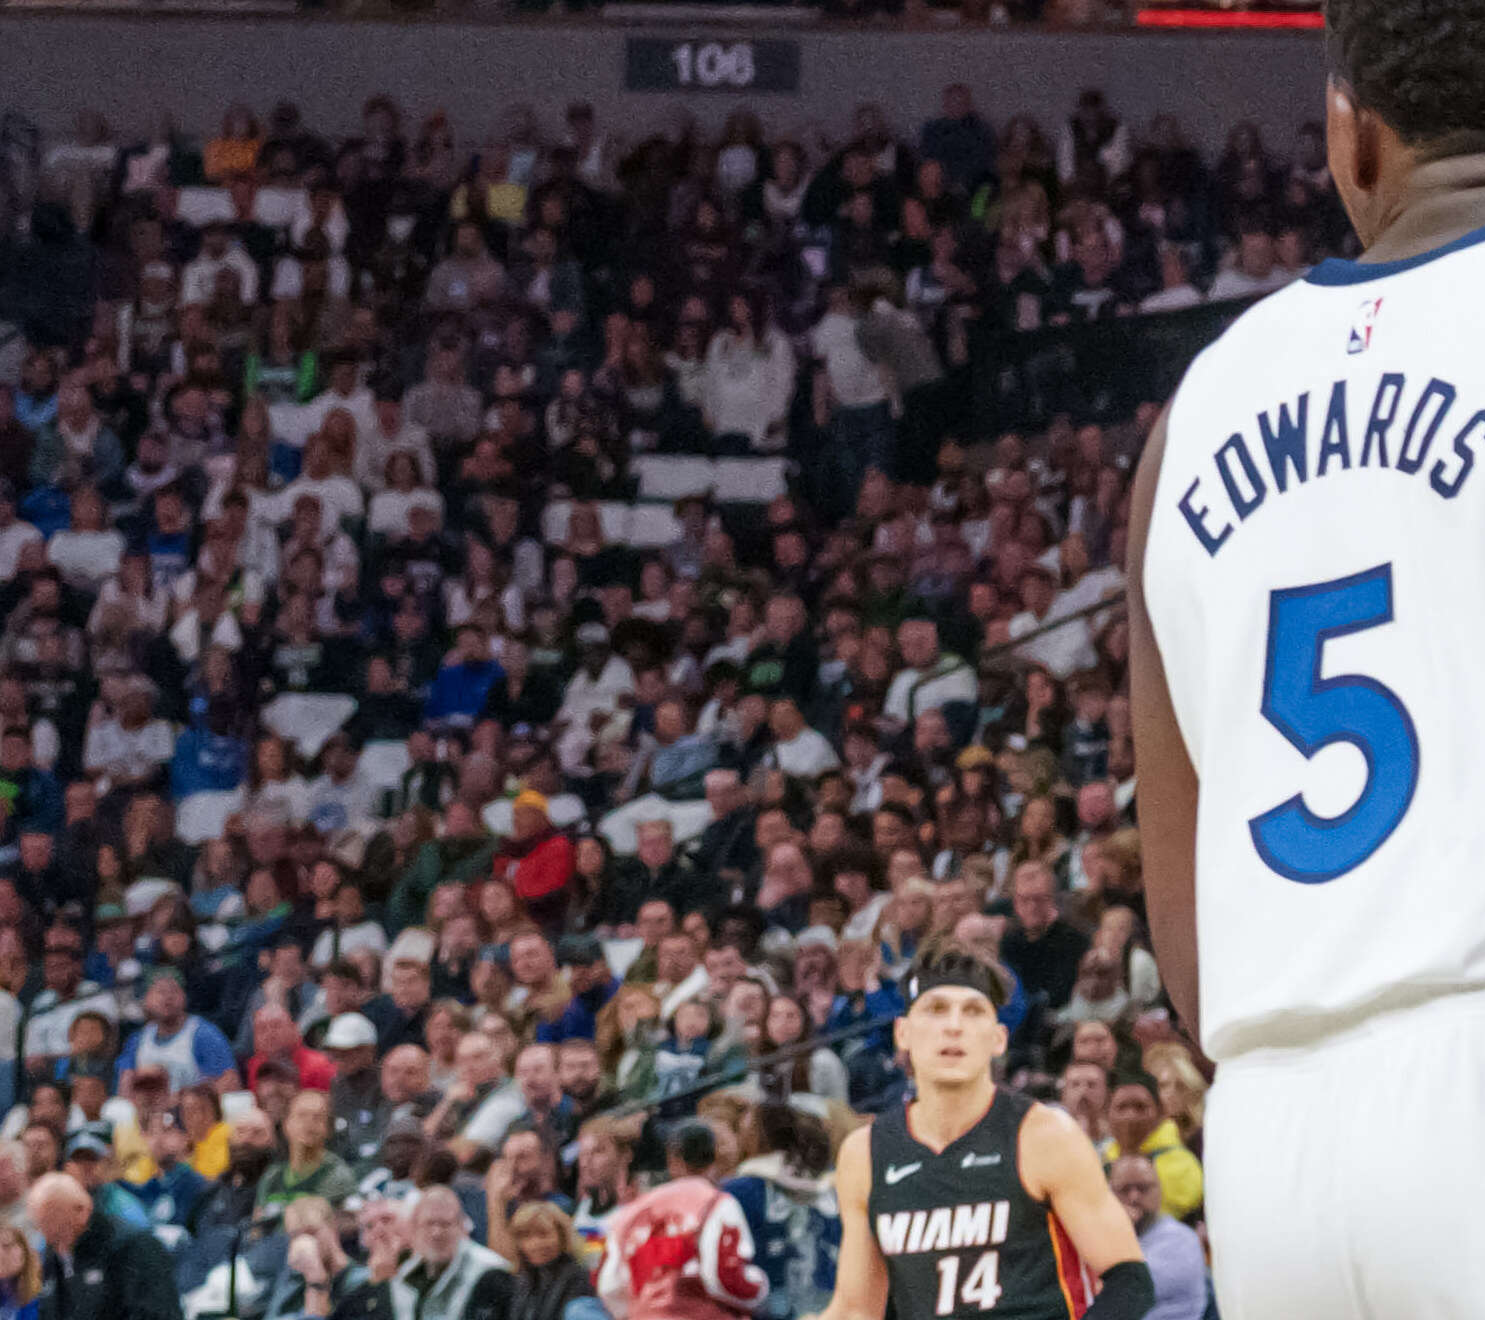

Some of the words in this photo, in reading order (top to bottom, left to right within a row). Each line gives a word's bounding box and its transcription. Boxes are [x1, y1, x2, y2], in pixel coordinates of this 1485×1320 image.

[1249, 562, 1420, 884] 5
[876, 1199, 1011, 1256] MIAMI
[935, 1250, 1003, 1317] 14
